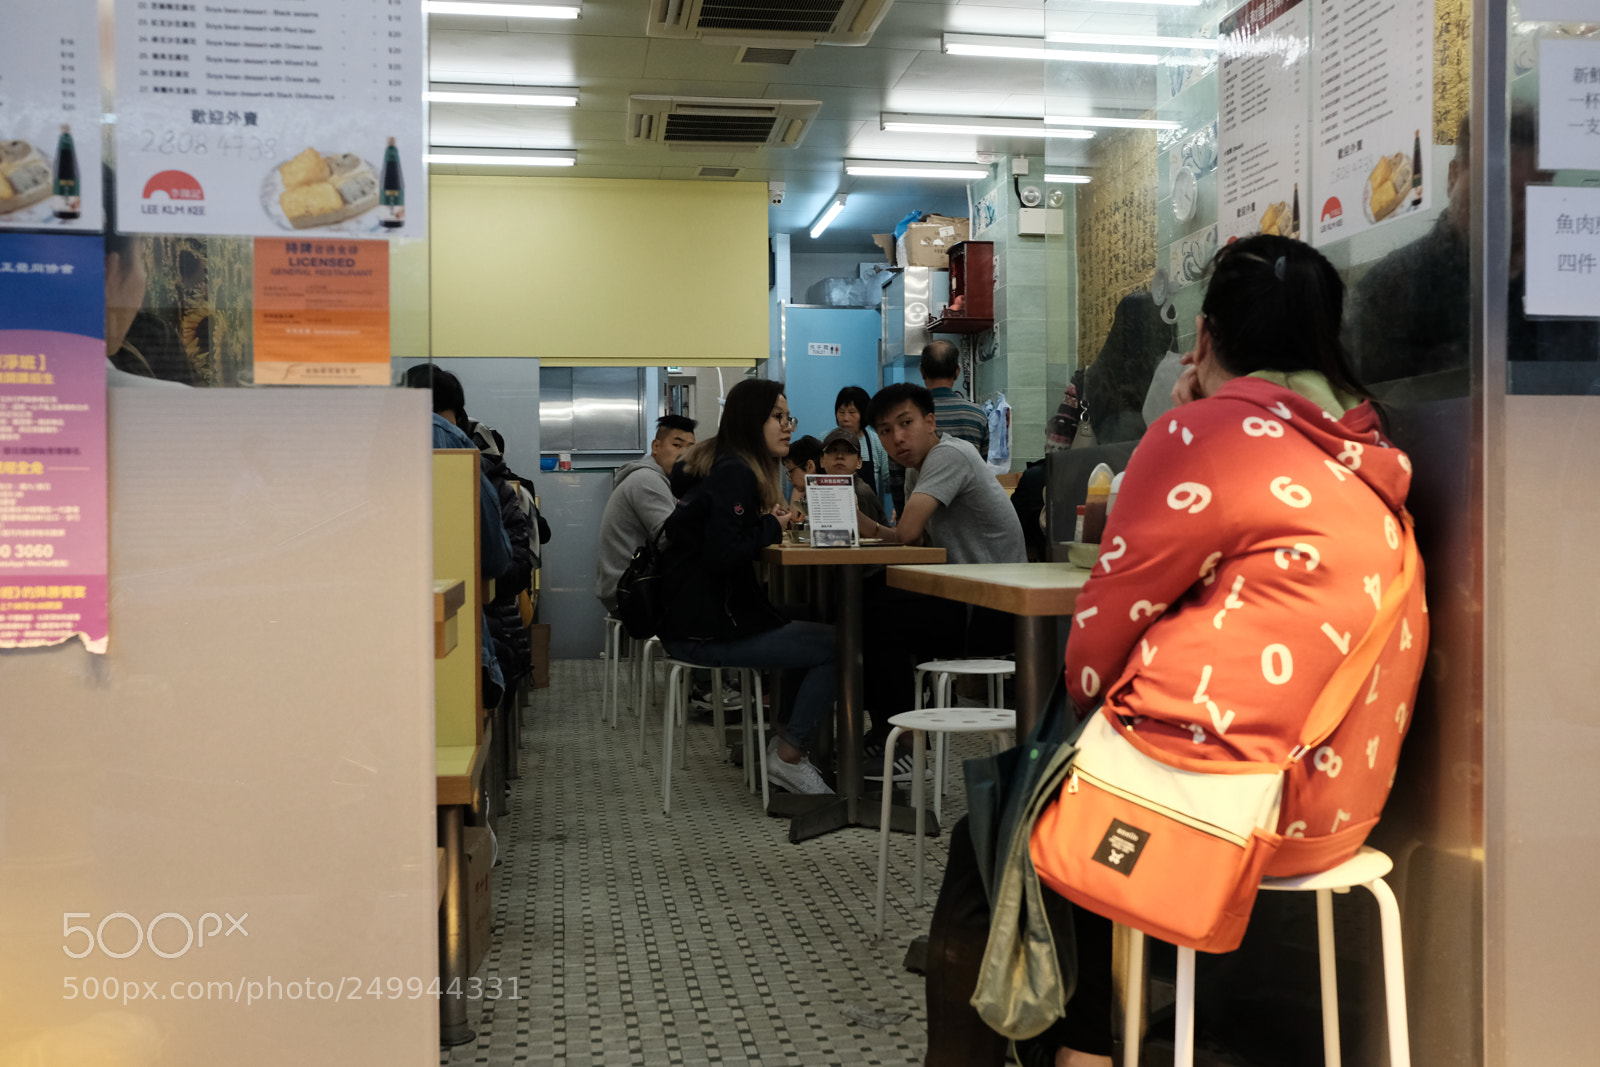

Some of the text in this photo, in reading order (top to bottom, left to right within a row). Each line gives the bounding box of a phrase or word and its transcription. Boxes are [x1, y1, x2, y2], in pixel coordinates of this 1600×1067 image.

[191, 109, 258, 126] 歡迎外賣
[141, 204, 206, 216] LEE KUM KEE
[1556, 213, 1600, 235] 魚肉
[270, 268, 374, 278] GENERAL RESTAURANT
[288, 257, 356, 268] LICENSED
[1558, 253, 1597, 274] 四件
[1243, 416, 1284, 438] 8
[1100, 536, 1126, 573] 2
[1261, 643, 1294, 685] 0
[1314, 746, 1343, 778] 8
